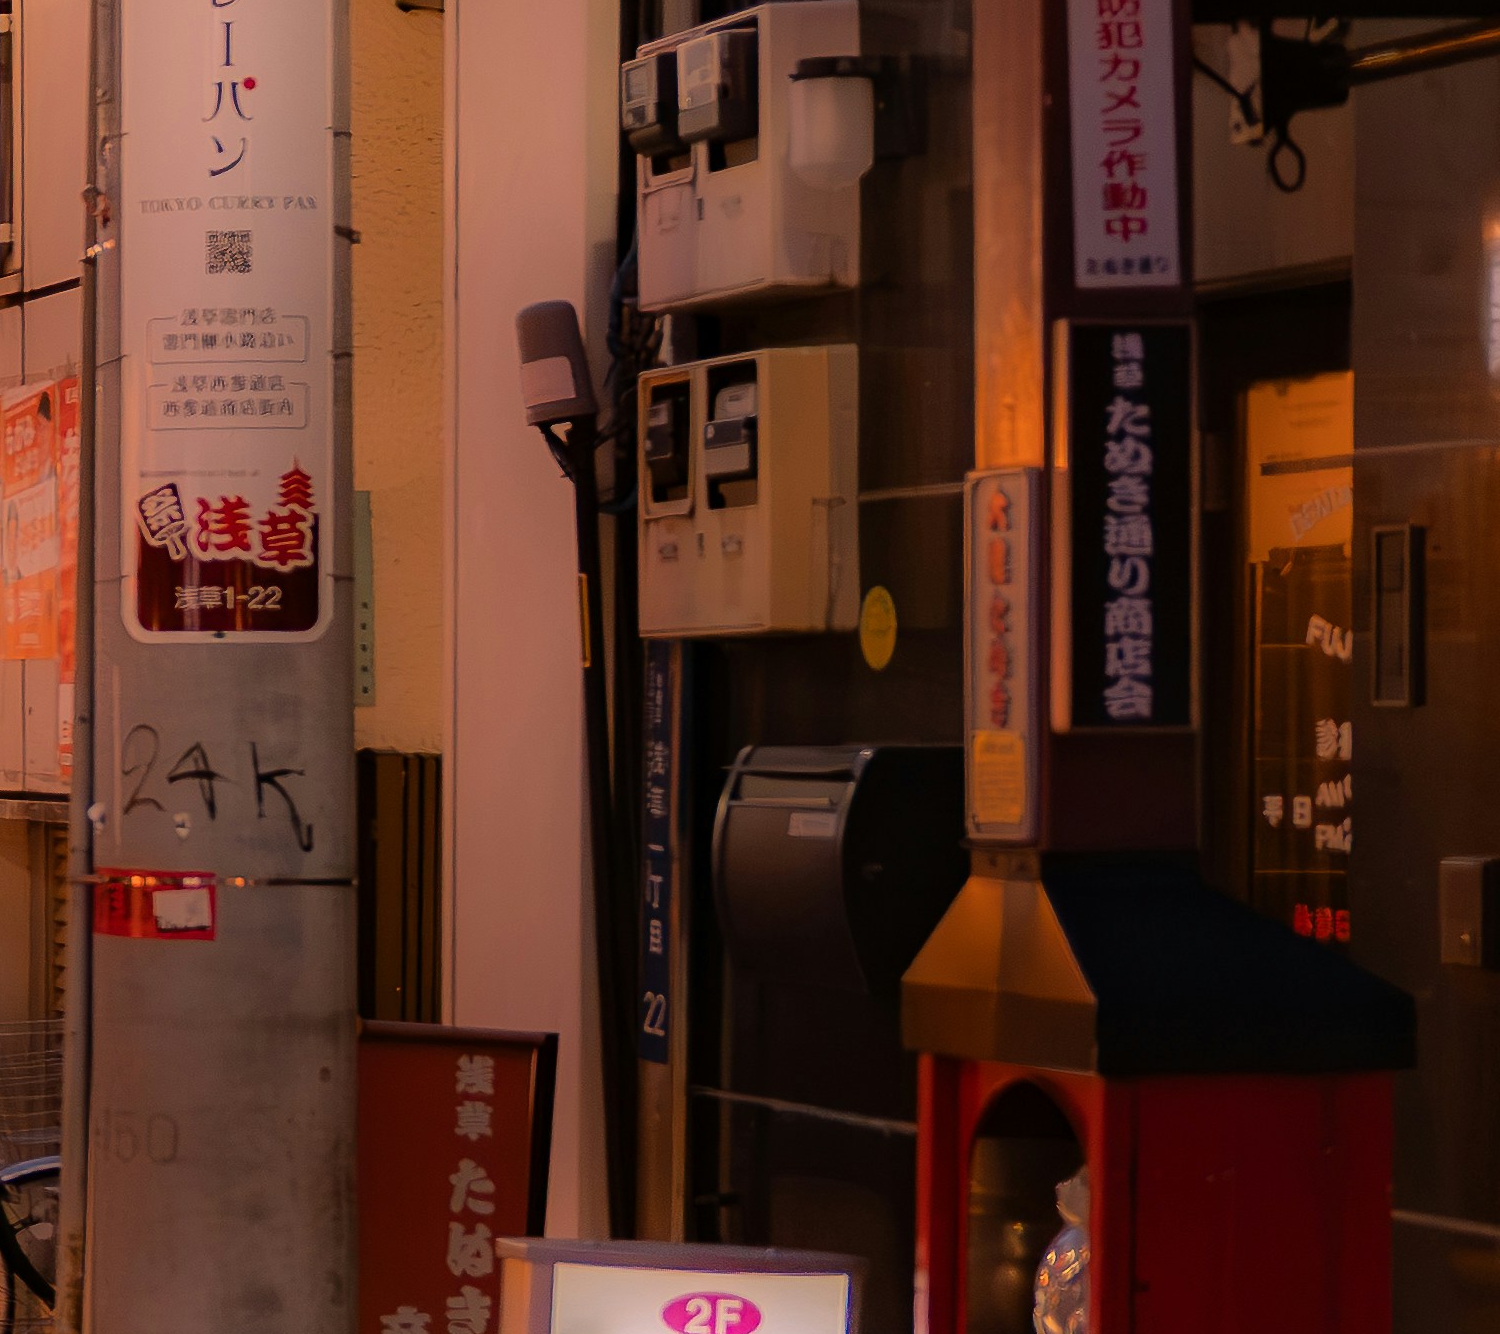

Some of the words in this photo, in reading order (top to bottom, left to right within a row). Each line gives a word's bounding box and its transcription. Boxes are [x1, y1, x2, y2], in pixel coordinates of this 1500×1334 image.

[196, 495, 308, 567] 浅草
[1102, 395, 1155, 721] たぬき通り商店会
[643, 990, 667, 1037] 22
